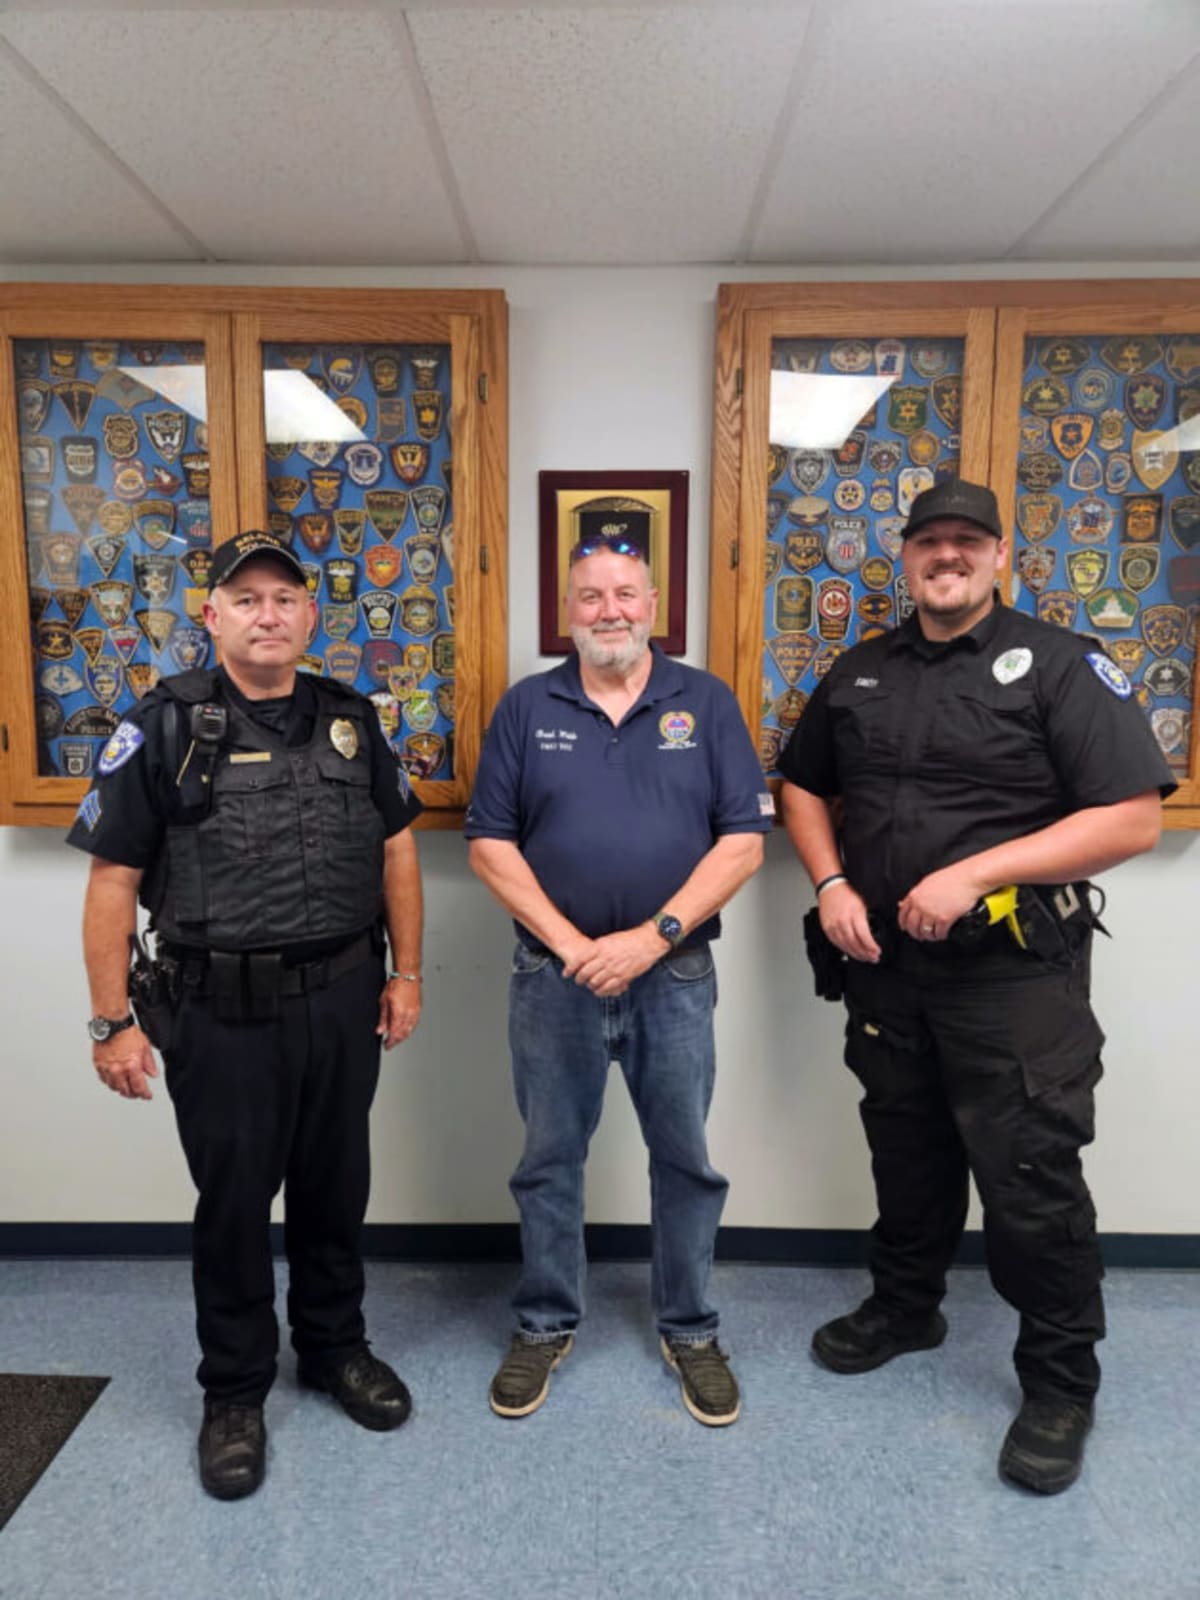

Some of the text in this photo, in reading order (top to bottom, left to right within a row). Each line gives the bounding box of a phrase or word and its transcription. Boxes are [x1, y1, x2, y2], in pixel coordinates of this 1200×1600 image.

[833, 520, 862, 529] POLICE
[788, 536, 818, 547] POLICE
[775, 647, 812, 658] POLICE
